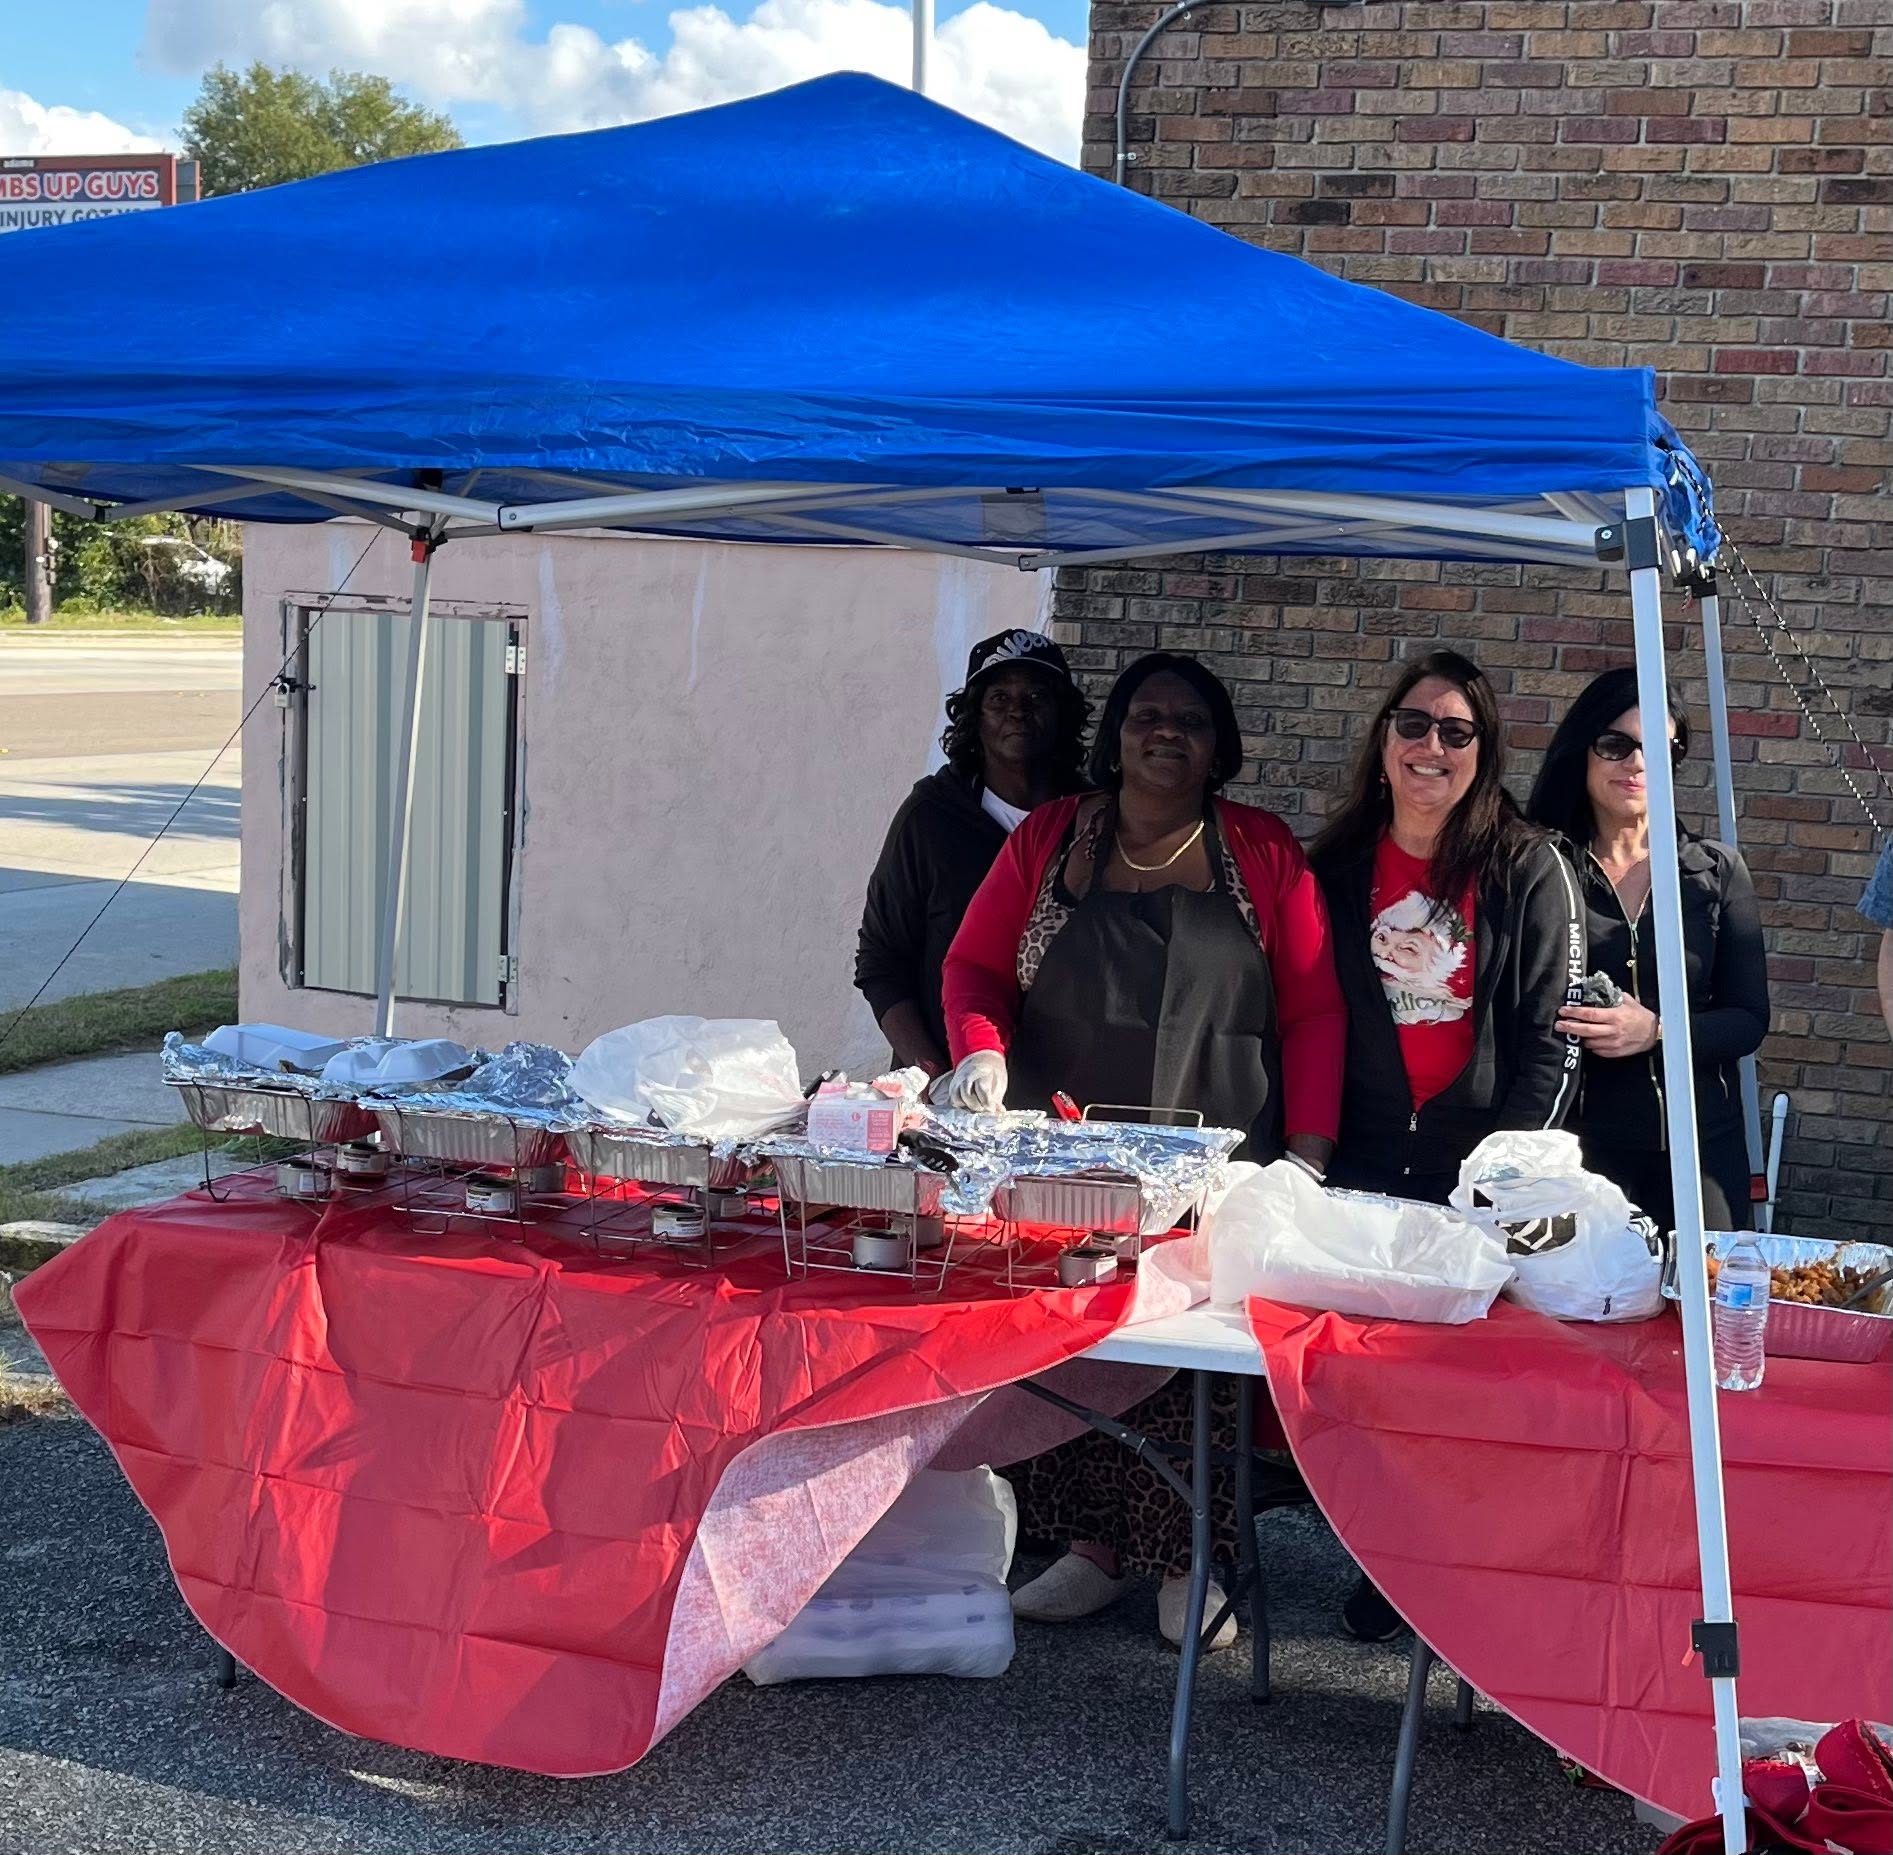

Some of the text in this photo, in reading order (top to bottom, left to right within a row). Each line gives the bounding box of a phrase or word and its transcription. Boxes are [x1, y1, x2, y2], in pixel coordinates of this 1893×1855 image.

[44, 174, 81, 198] UP
[86, 173, 157, 197] GUYS
[0, 208, 65, 229] INJURY
[1563, 1030, 1580, 1071] ORS
